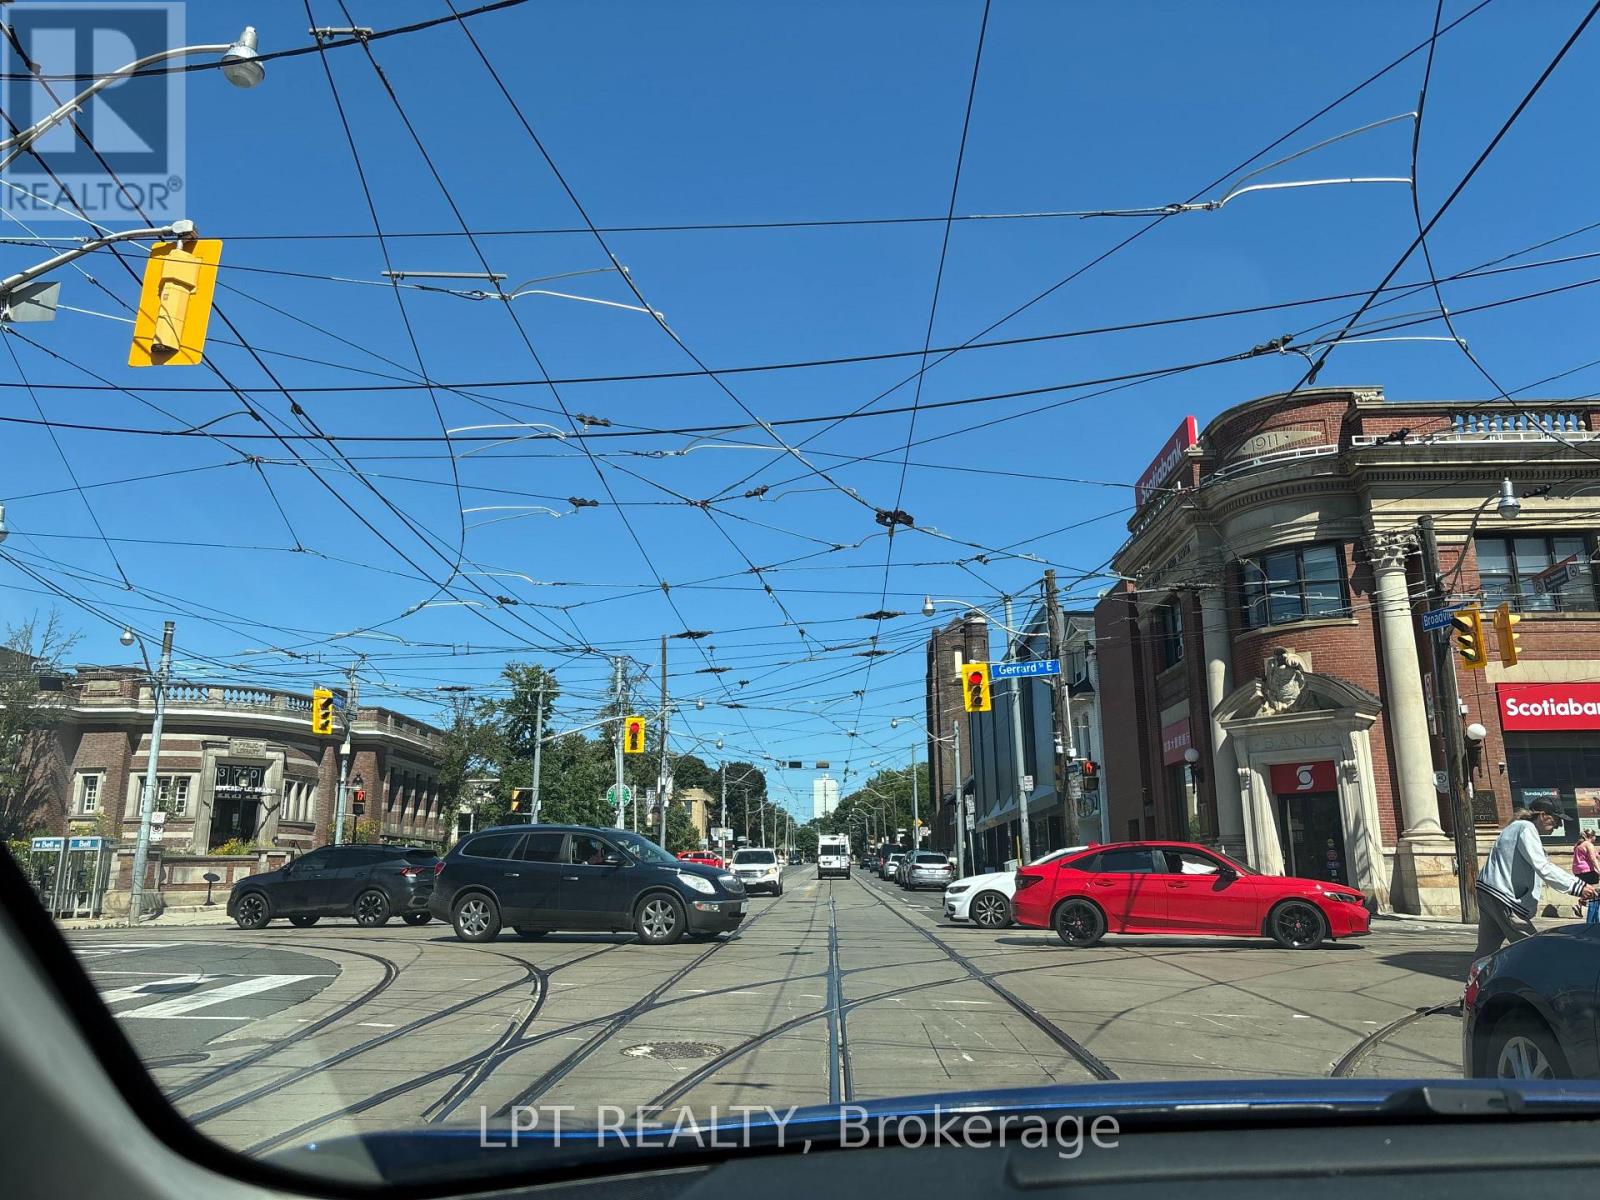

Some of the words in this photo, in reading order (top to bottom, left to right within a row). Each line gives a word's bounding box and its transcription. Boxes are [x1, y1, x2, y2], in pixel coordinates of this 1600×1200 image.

[998, 662, 1037, 675] Gerrard
[1046, 661, 1053, 672] E
[1505, 697, 1600, 717] Scotiaba
[1264, 733, 1326, 750] BANK
[42, 840, 54, 848] Bell
[79, 840, 91, 848] Bell
